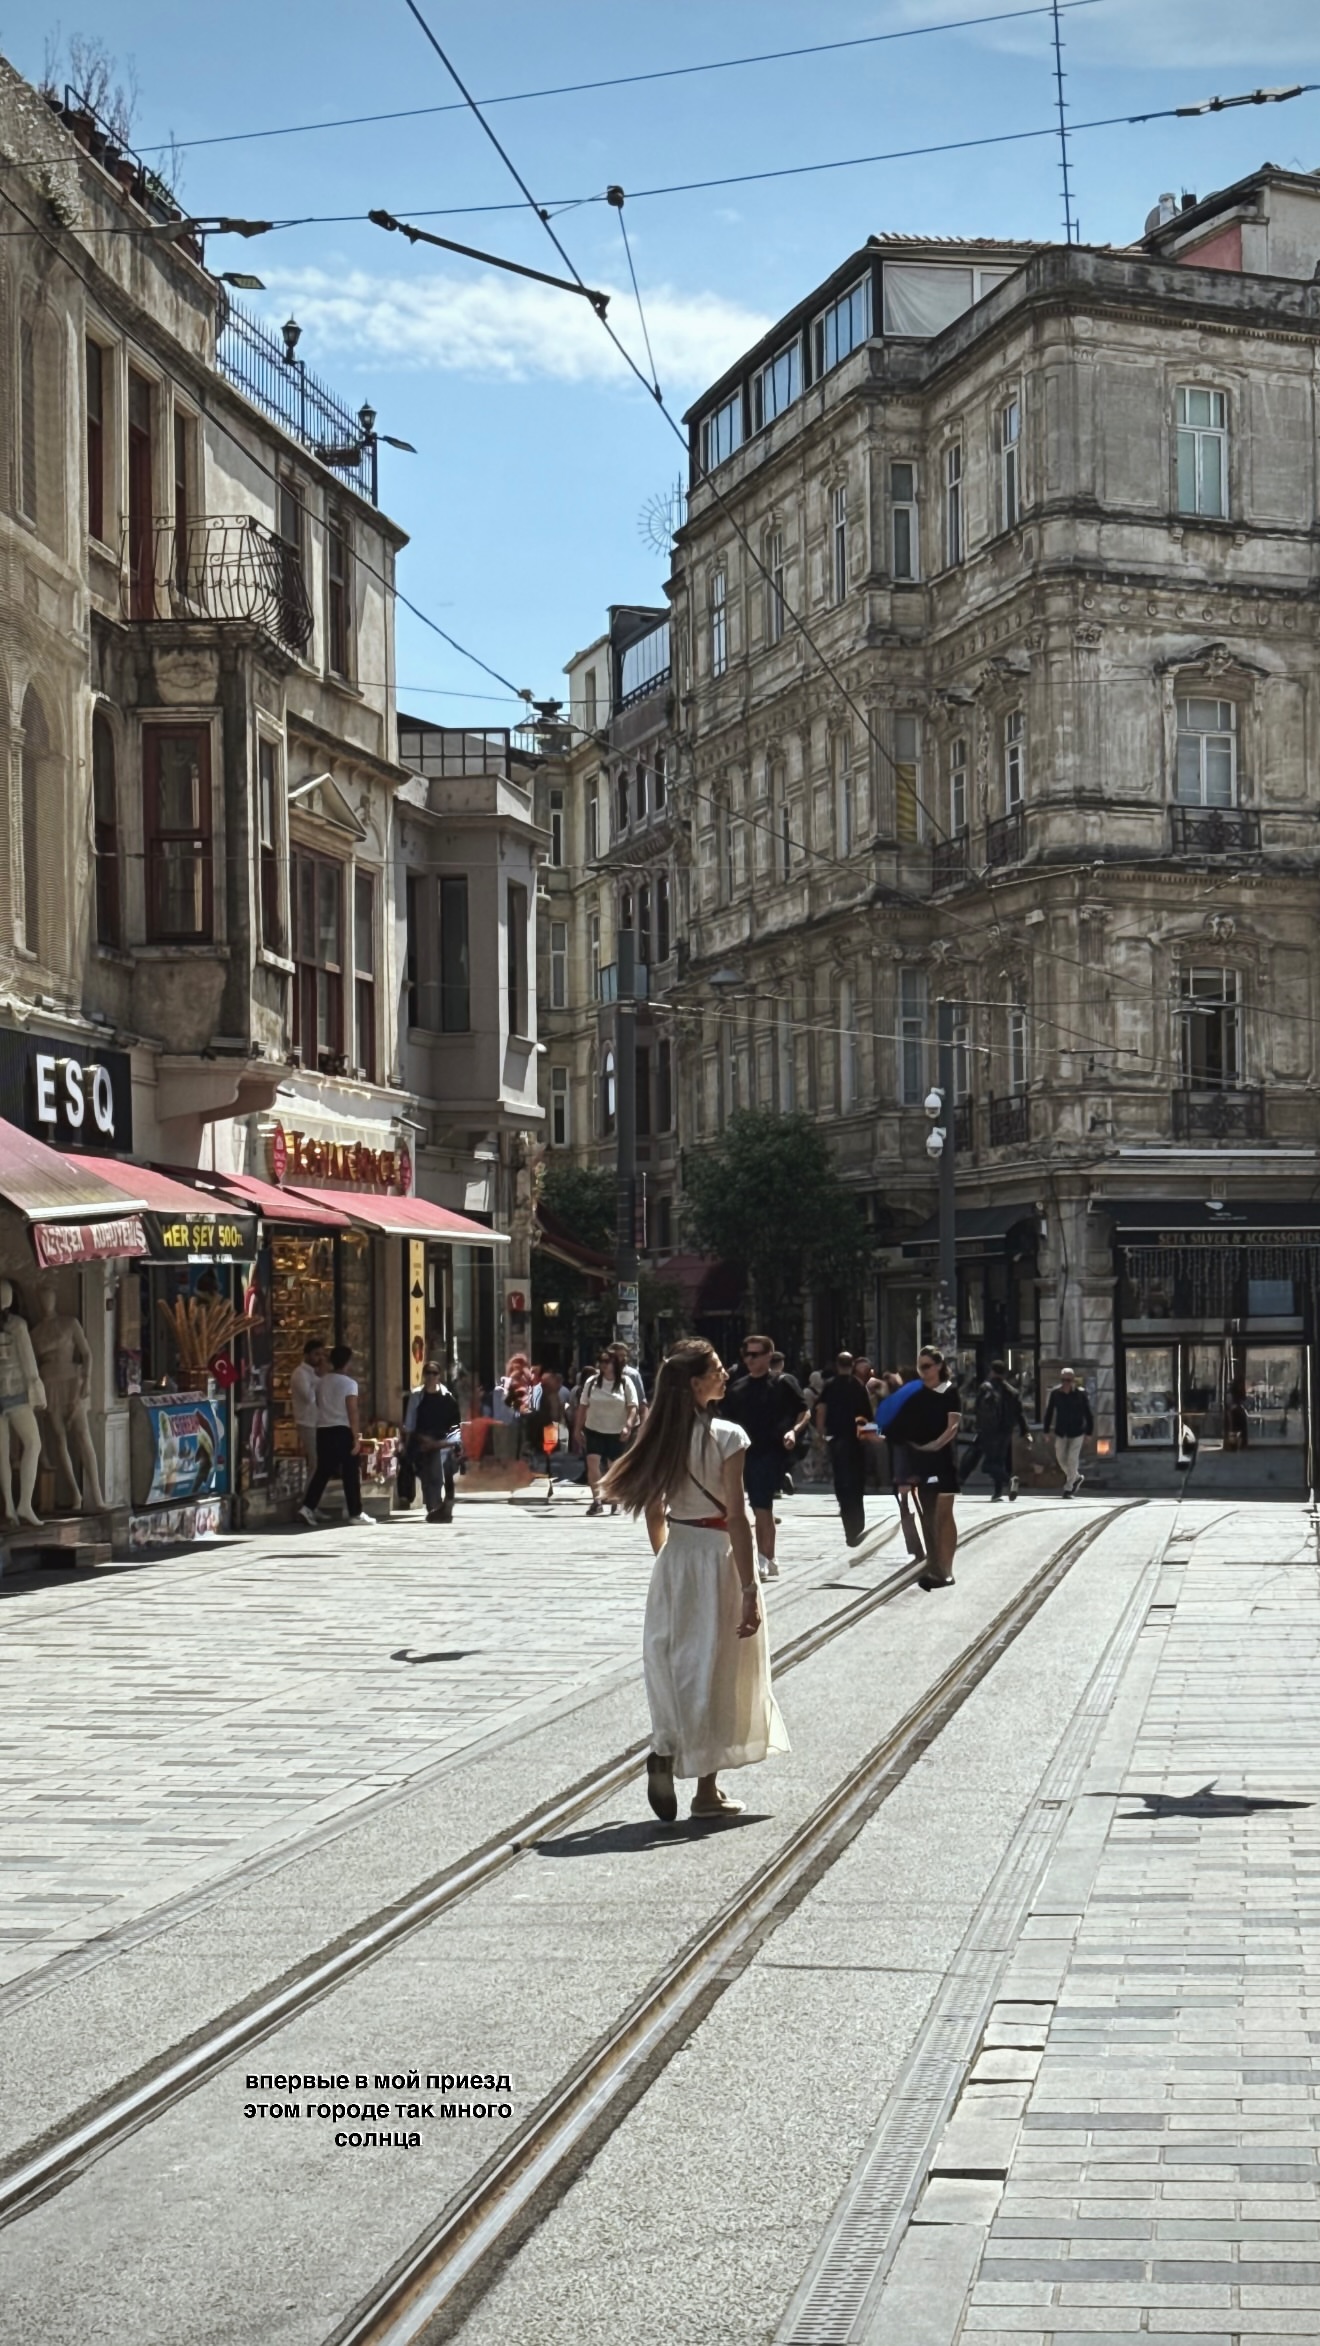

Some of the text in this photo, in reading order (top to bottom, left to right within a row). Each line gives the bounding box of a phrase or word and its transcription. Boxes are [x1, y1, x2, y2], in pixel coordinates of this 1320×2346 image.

[36, 1054, 115, 1138] ESQ
[163, 1224, 190, 1247] HER
[192, 1224, 215, 1253] ŞEY
[1190, 1232, 1229, 1244] SILVER
